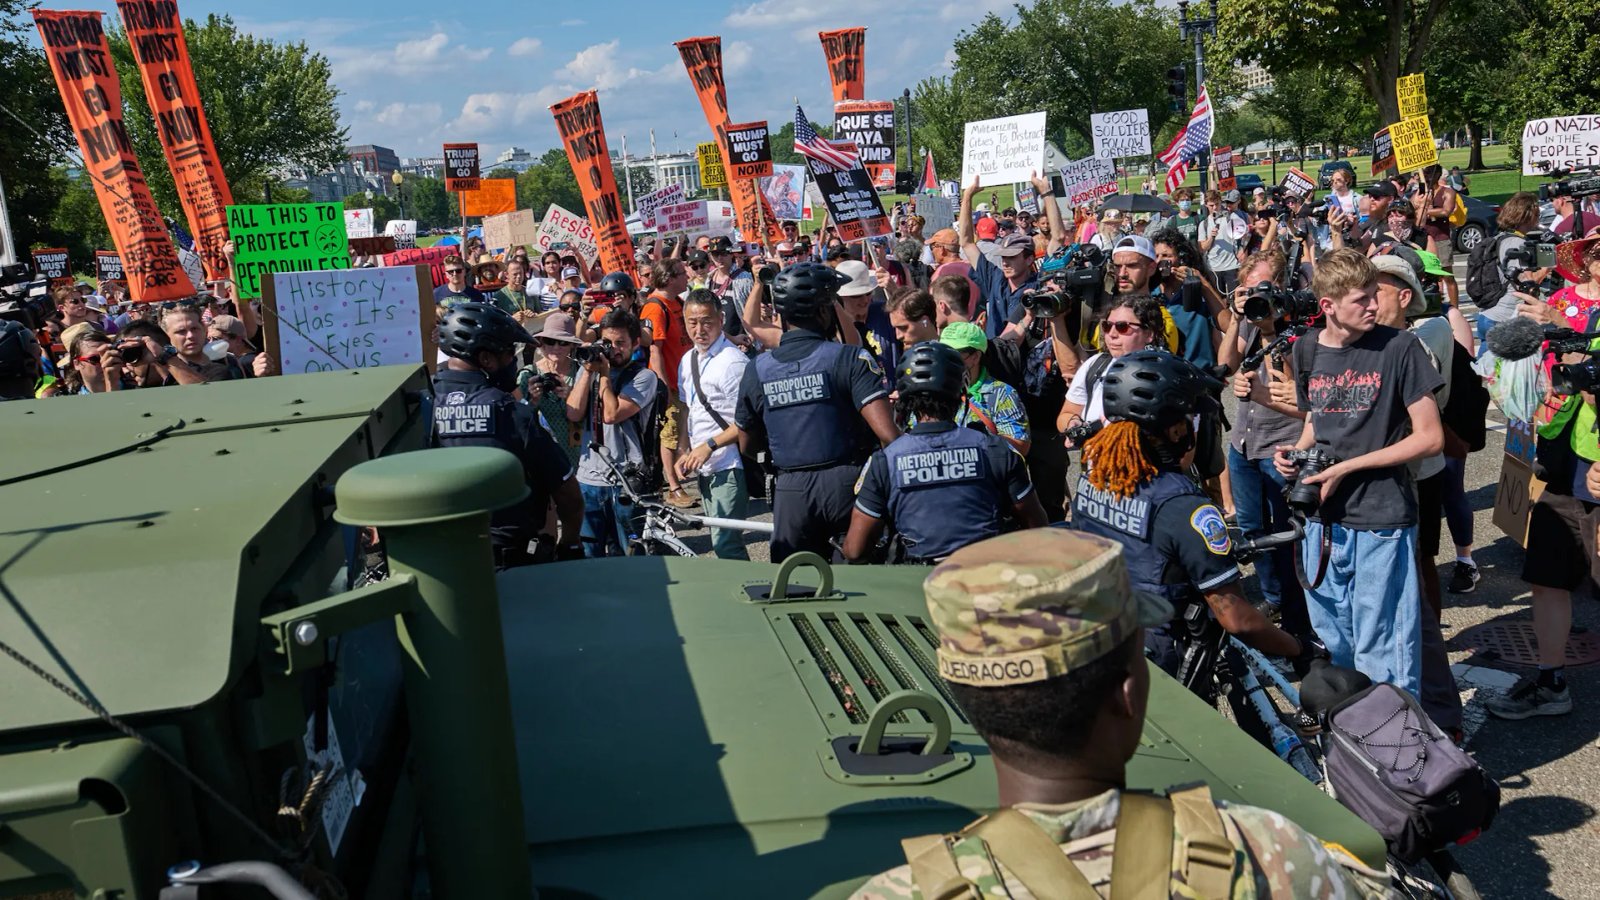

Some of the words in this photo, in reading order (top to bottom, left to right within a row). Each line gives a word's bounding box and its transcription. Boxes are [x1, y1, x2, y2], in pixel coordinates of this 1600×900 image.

[117, 0, 177, 31] TRUMP
[35, 16, 103, 47] TRUMP
[135, 33, 180, 64] MUST
[820, 32, 865, 60] TRUMP
[56, 49, 109, 80] MUST
[159, 71, 182, 102] GO
[1400, 80, 1409, 88] DC
[1409, 76, 1423, 86] SAYS
[1399, 87, 1415, 97] STOP
[1416, 85, 1425, 95] THE
[84, 84, 110, 116] GO
[1401, 96, 1425, 106] MILITARY
[1402, 104, 1425, 115] TAKEOVER
[836, 114, 870, 133] ¡QUE
[874, 113, 894, 129] SE
[1103, 112, 1138, 124] GOOD
[158, 106, 203, 146] NOW
[971, 122, 1019, 135] Militarizing
[1095, 121, 1149, 137] SOLDIERS
[1394, 125, 1405, 136] DC
[1405, 119, 1426, 133] SAYS
[1527, 120, 1549, 137] NO
[1555, 116, 1600, 133] NAZIS
[80, 119, 134, 163] NOW
[729, 129, 766, 143] TRUMP
[846, 130, 884, 145] VAYA
[969, 137, 993, 148] Cities
[1000, 133, 1008, 144] To
[1011, 125, 1045, 140] Distract
[1102, 137, 1143, 148] FOLLOW
[1375, 133, 1391, 146] TRU
[1394, 133, 1414, 148] STOP
[1416, 128, 1431, 140] THE
[1545, 135, 1554, 144] IN
[1557, 134, 1581, 143] THE
[570, 130, 602, 163] MST
[699, 144, 719, 155] NATIO
[734, 140, 763, 153] MUST
[1101, 146, 1145, 158] ORDERS
[1377, 142, 1393, 155] MUS
[1399, 141, 1430, 157] MILITARY
[1530, 142, 1599, 157] PEOPLE'S
[446, 149, 477, 159] TRUMP
[705, 154, 721, 165] GUA
[742, 152, 758, 162] GO
[859, 147, 891, 161] UMP
[968, 149, 990, 160] From
[1215, 151, 1231, 162] TRUMP
[1380, 150, 1389, 159] GO
[1400, 150, 1435, 167] TAKEOVER
[450, 159, 475, 168] MUST
[738, 163, 768, 176] NOW!
[980, 160, 998, 172] Not
[1217, 161, 1231, 171] MUST
[457, 168, 471, 177] GO
[705, 174, 725, 184] STREE
[834, 171, 854, 187] ICE!
[1065, 172, 1088, 186] LIKE
[1221, 170, 1229, 178] GO
[452, 180, 477, 190] NOW!
[1284, 180, 1308, 196] MUST
[1287, 172, 1314, 190] TRUMP
[639, 193, 657, 206] THE
[116, 216, 127, 224] TO
[231, 208, 258, 228] ALL
[267, 206, 307, 226] THIS
[315, 206, 336, 221] TO
[395, 224, 407, 233] NO
[542, 223, 559, 237] Like
[550, 209, 597, 243] Resist
[843, 222, 863, 232] TRUM
[853, 229, 864, 237] GO
[235, 230, 309, 255] PROTECT
[394, 233, 416, 243] SCIST
[125, 245, 174, 262] REFUSE
[578, 241, 597, 257] 1938
[36, 253, 67, 262] TRUMP
[41, 262, 65, 270] MUST
[127, 259, 179, 275] FASCISM
[47, 270, 61, 278] GO
[290, 272, 386, 305] History
[294, 306, 334, 336] Has
[354, 297, 397, 326] Its
[326, 332, 375, 357] Eyes
[763, 373, 824, 396] METROPOLITAN
[768, 386, 823, 406] POLICE
[435, 404, 490, 420] ROPOLITAN
[436, 418, 487, 434] OLICE
[897, 448, 979, 470] METROPOLITAN
[903, 462, 977, 485] POLICE
[1077, 496, 1141, 535] POLICE
